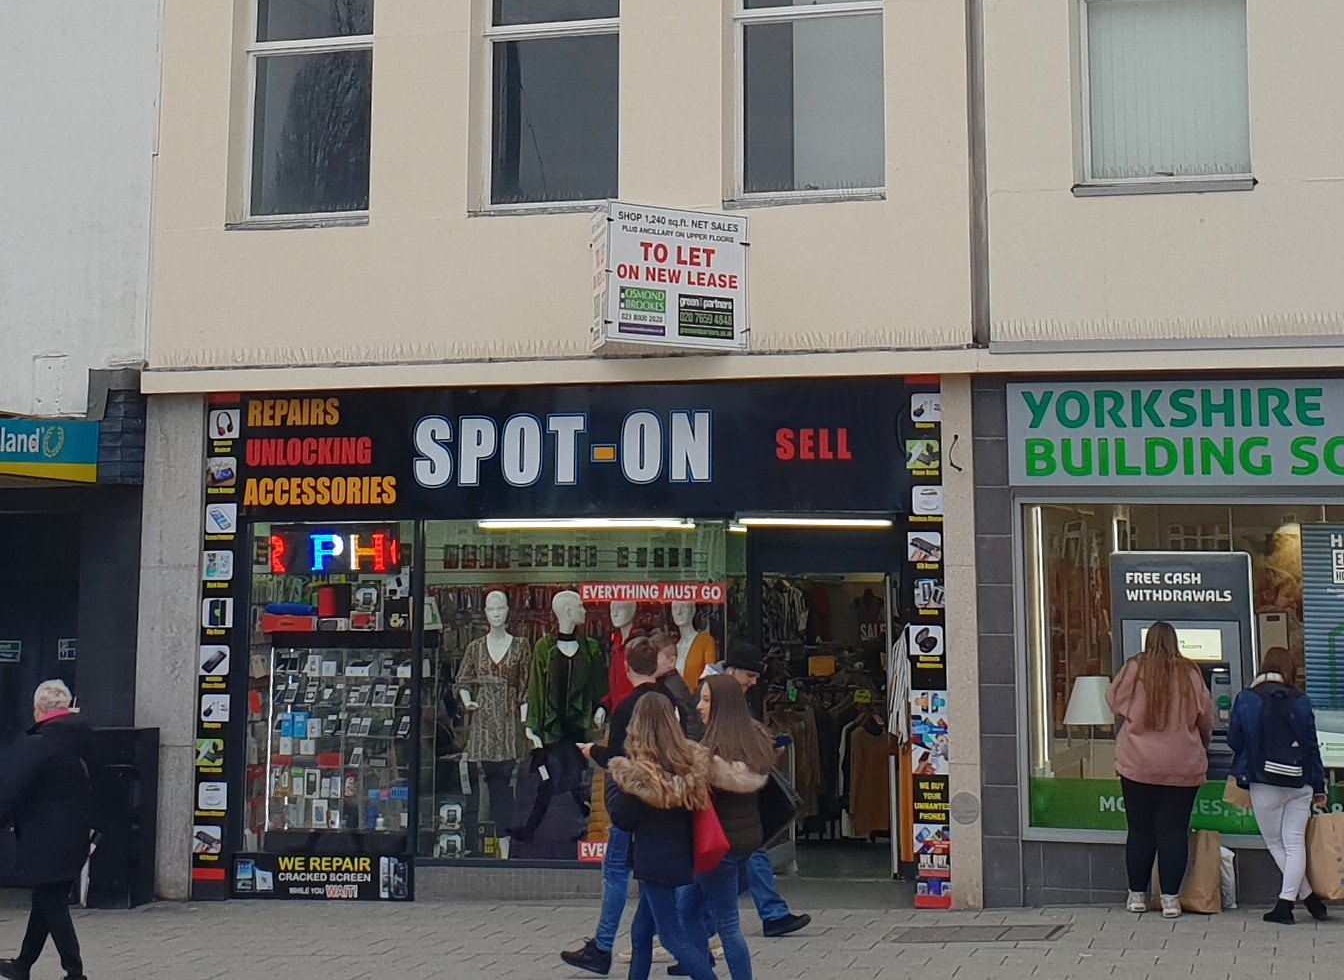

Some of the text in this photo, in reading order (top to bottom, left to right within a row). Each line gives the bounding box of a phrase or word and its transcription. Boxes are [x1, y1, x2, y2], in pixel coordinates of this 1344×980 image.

[618, 211, 642, 222] SHOP
[645, 214, 666, 225] 1,240
[691, 221, 708, 229] NET
[711, 222, 738, 232] SALES
[622, 225, 638, 233] PLUS
[639, 227, 673, 237] ANCILLARY
[686, 232, 707, 240] UPPER
[709, 234, 734, 243] FLOORS
[640, 241, 715, 267] TO LET
[617, 264, 738, 289] ON NEW LEASE
[625, 288, 664, 301] OSMOND
[247, 398, 340, 427] REPAIRS
[1021, 387, 1325, 428] YORKSHIRE
[246, 436, 372, 466] UNLOCKING
[413, 408, 712, 487] SPOT-ON
[774, 427, 851, 460] SELL
[1025, 436, 1272, 476] BUILDING
[243, 475, 397, 506] ACCESSORIES
[1125, 572, 1202, 585] FREE CASH
[582, 584, 722, 600] EVERYTHING MUST GO
[1126, 589, 1233, 602] WITHDRAWALS
[278, 857, 371, 871] WE REPAIR
[278, 872, 371, 882] CRACKED SCREEN
[311, 887, 324, 895] YOU
